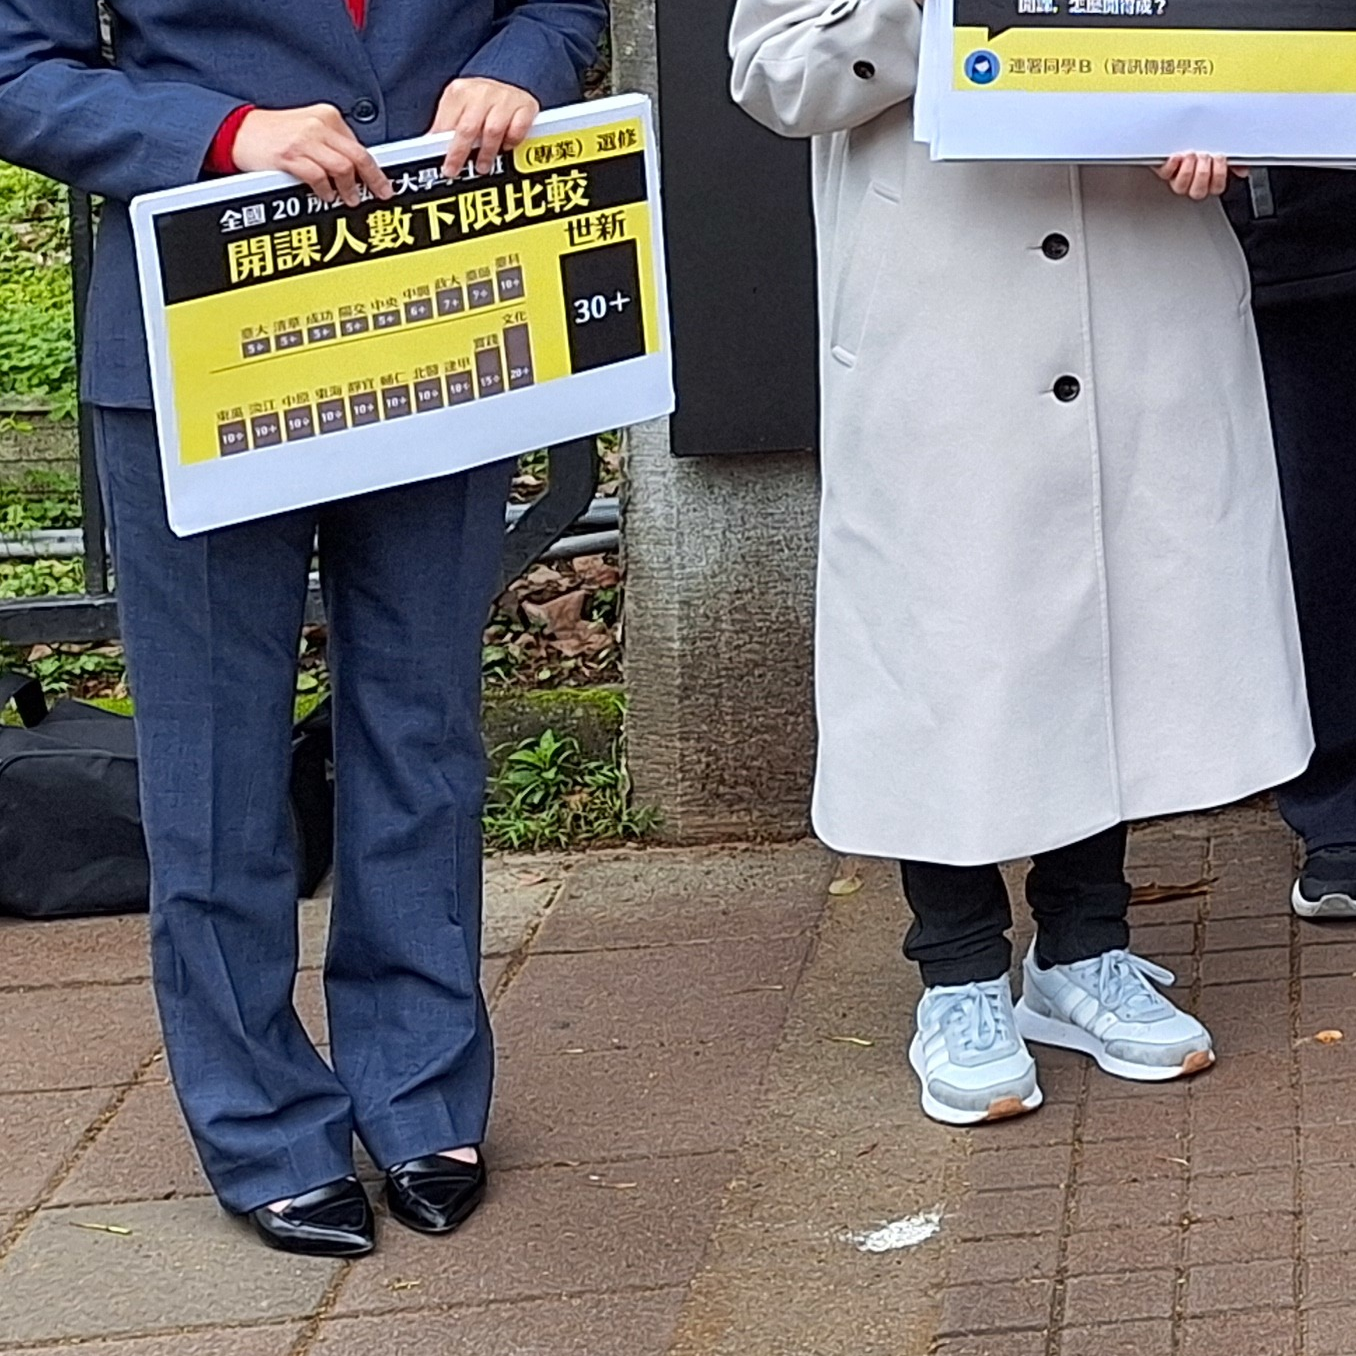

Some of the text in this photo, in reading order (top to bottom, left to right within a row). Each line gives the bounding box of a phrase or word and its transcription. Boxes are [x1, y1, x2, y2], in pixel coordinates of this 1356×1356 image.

[220, 205, 266, 233] 全國
[272, 196, 300, 220] 20
[227, 169, 590, 283] 開課人數下限比較
[564, 210, 626, 247] 世新
[503, 311, 527, 324] 文化
[574, 288, 631, 325] 30+
